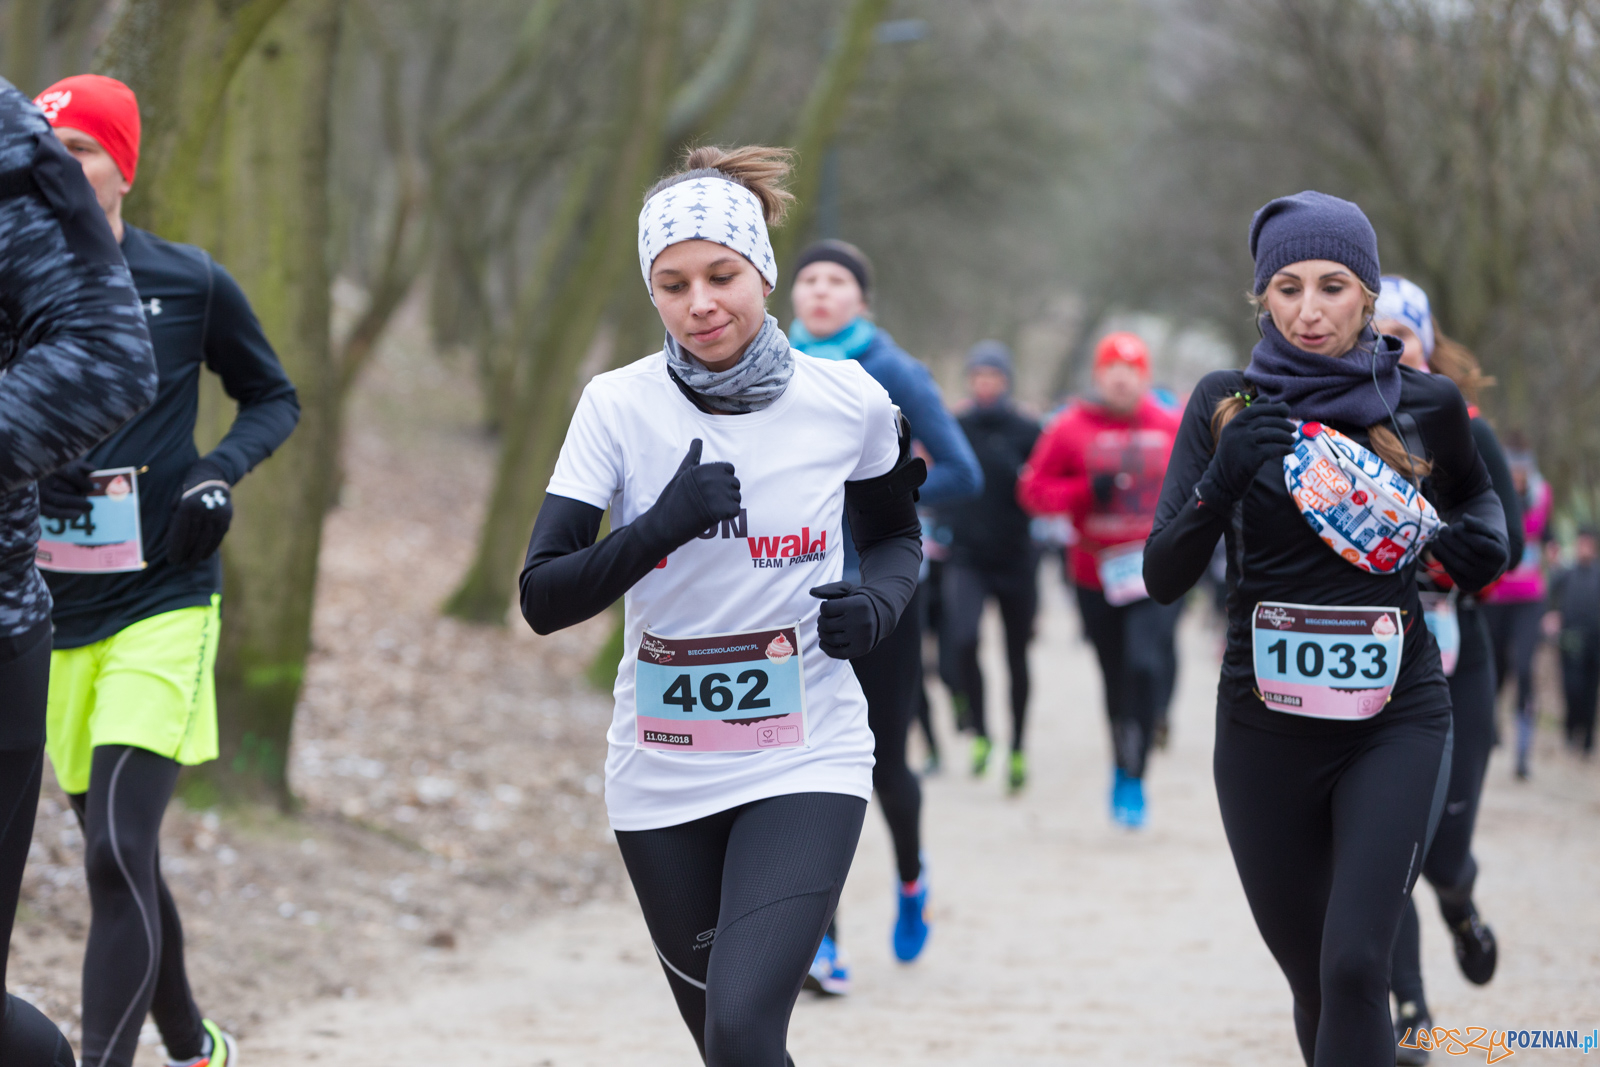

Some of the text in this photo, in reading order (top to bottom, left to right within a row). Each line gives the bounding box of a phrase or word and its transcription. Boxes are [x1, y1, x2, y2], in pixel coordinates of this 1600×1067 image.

[747, 526, 827, 558] wald
[752, 558, 783, 568] TEAM
[688, 644, 758, 656] BIEGCZEKOLADOWY.PL
[1268, 638, 1388, 680] 1033
[662, 669, 771, 713] 462
[646, 732, 690, 744] 11.02.2018
